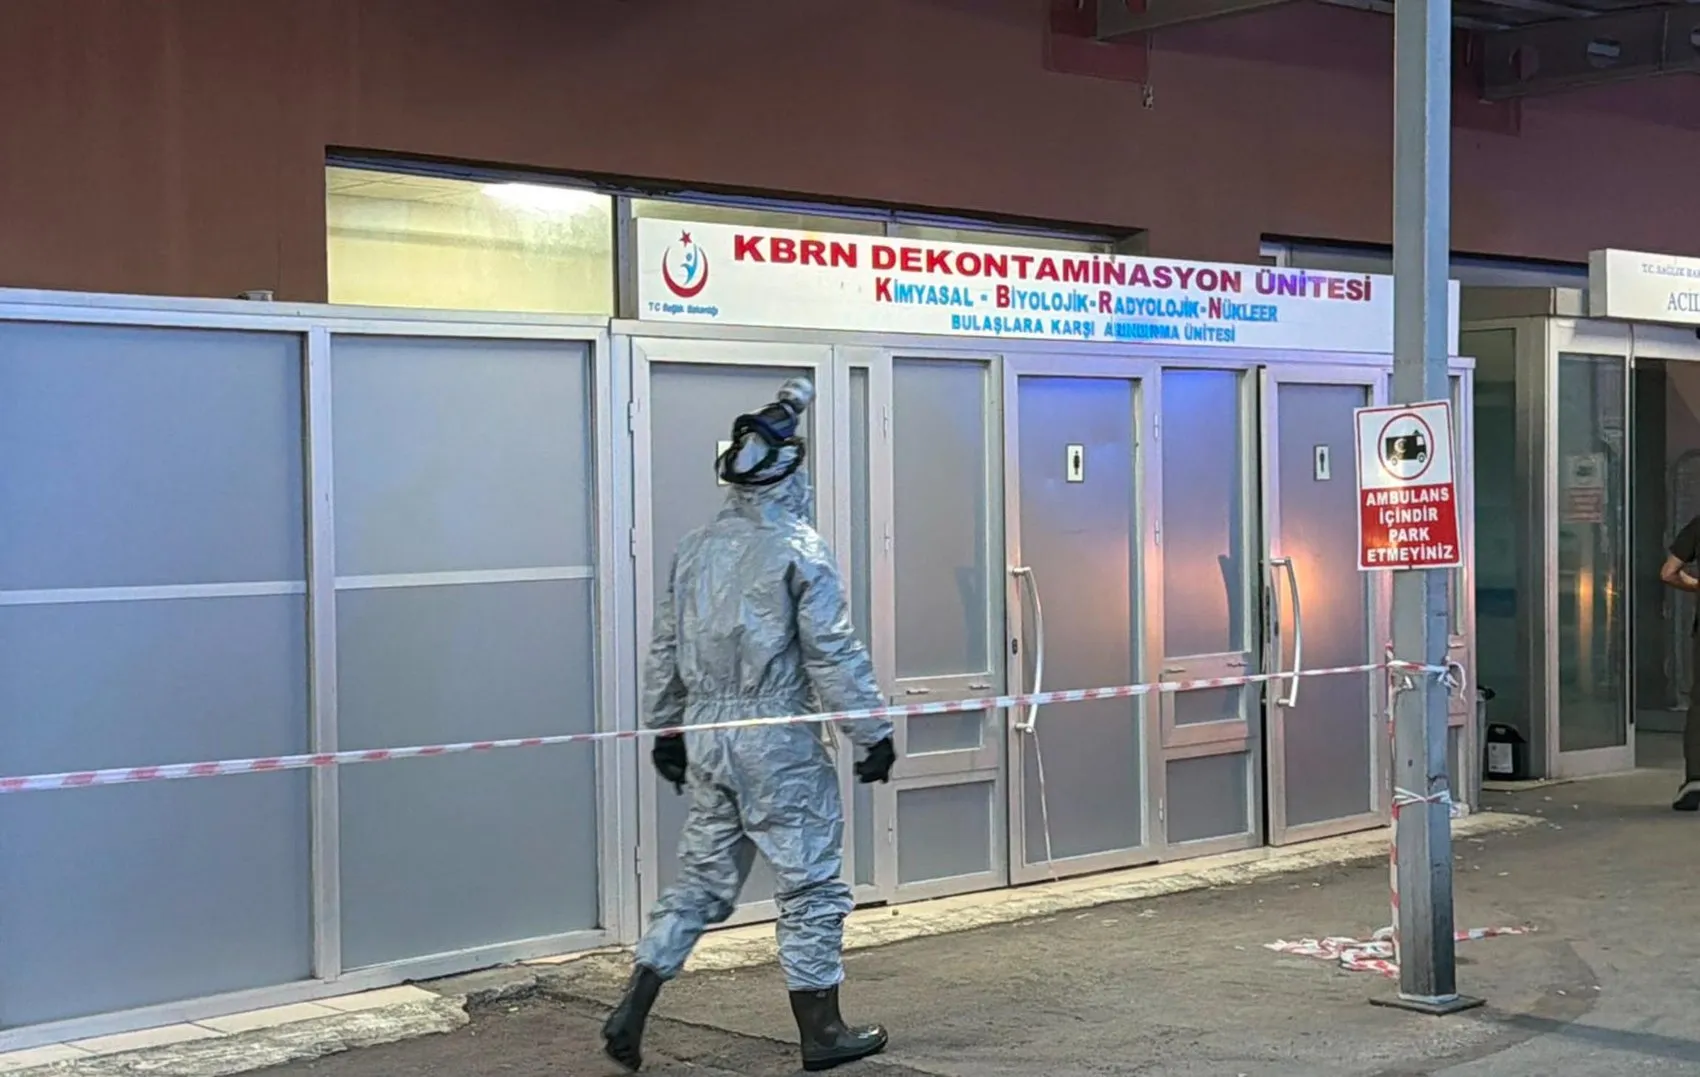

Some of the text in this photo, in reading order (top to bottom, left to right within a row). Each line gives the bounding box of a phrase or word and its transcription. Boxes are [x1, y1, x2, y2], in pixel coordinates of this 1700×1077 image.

[734, 234, 1372, 301] KBRN DEKONTAMİNASYON ÜNİTESİ
[875, 277, 974, 307] KİMYASAL
[951, 314, 1044, 335] BULAŞLARA
[1051, 319, 1095, 339] KARŞI
[1184, 323, 1236, 343] ÜNİTESİ
[1366, 487, 1450, 507] AMBULANS
[1379, 505, 1439, 528] İÇİNDİR
[1388, 527, 1431, 543] PARK
[1367, 544, 1454, 563] ETMEYİNİZ
